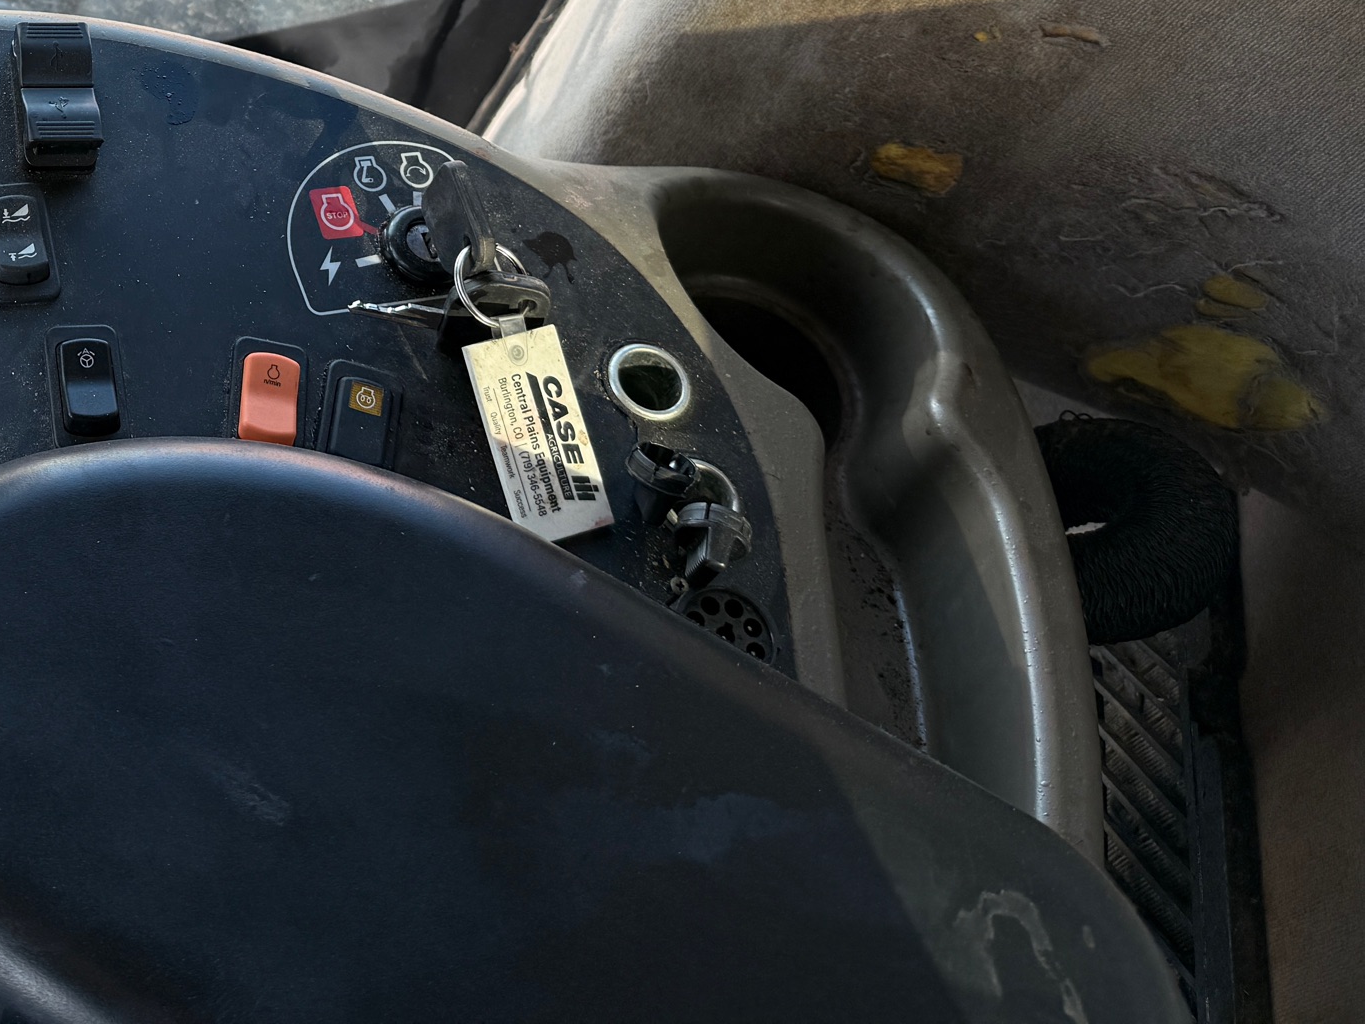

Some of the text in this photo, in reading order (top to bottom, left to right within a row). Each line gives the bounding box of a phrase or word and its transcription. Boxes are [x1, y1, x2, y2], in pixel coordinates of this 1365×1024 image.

[326, 211, 348, 220] STOP
[483, 385, 527, 519] Trust Quality Teamwork Success
[498, 377, 548, 517] Burlington, CO (719) 346-5548
[511, 373, 562, 513] Central Plains Equipment
[542, 375, 585, 464] CASE
[546, 433, 572, 498] AGRICULTURE
